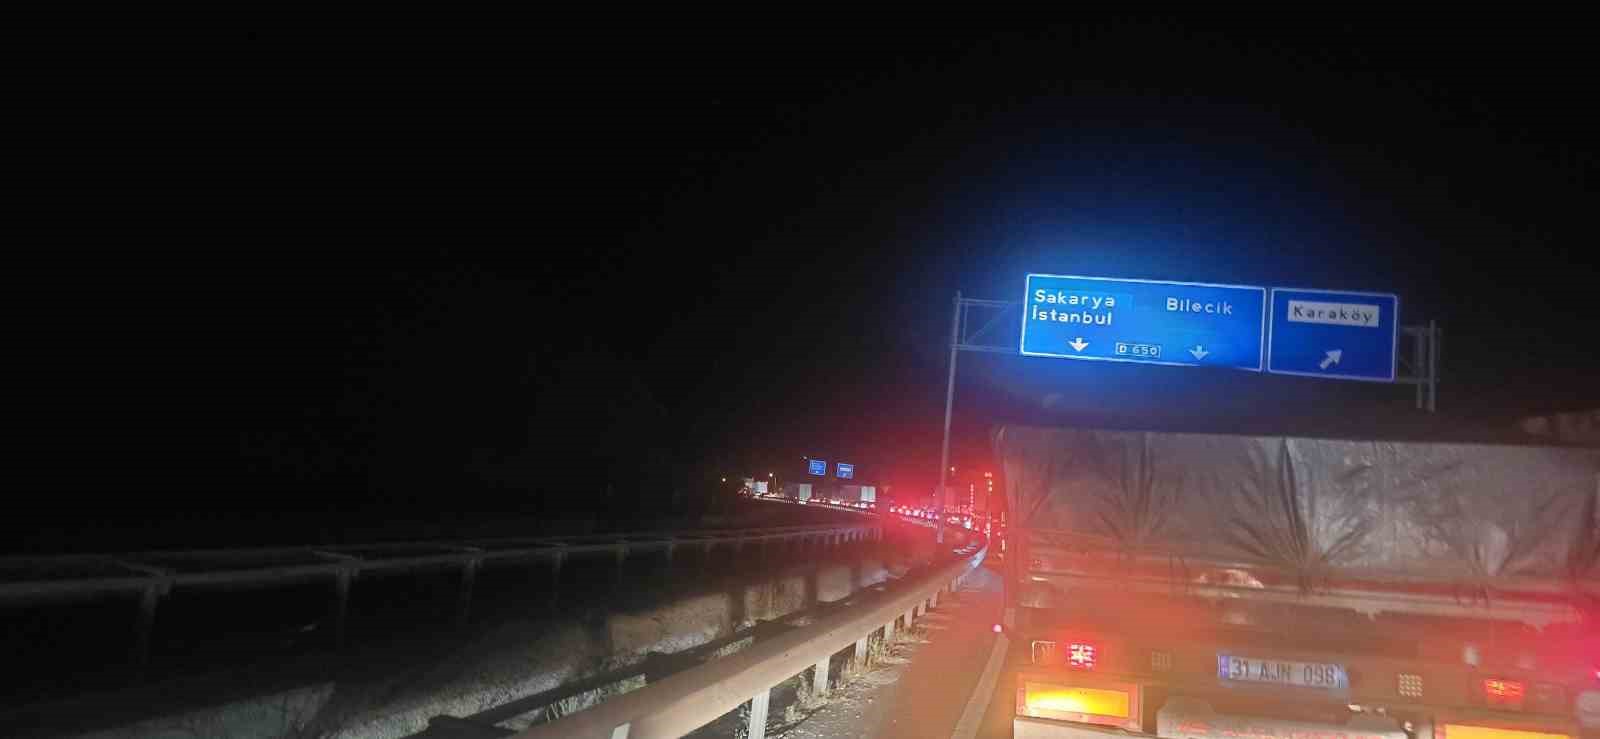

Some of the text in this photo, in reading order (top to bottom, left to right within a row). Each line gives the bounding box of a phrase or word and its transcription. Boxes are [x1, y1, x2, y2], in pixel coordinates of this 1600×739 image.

[1034, 289, 1116, 309] Sakarya
[1166, 297, 1233, 315] Bilecik
[1032, 305, 1112, 325] İstanbul
[1293, 305, 1373, 324] Karaköy
[1119, 344, 1158, 356] D 650
[1231, 658, 1249, 678] 31
[1303, 665, 1336, 685] 098
